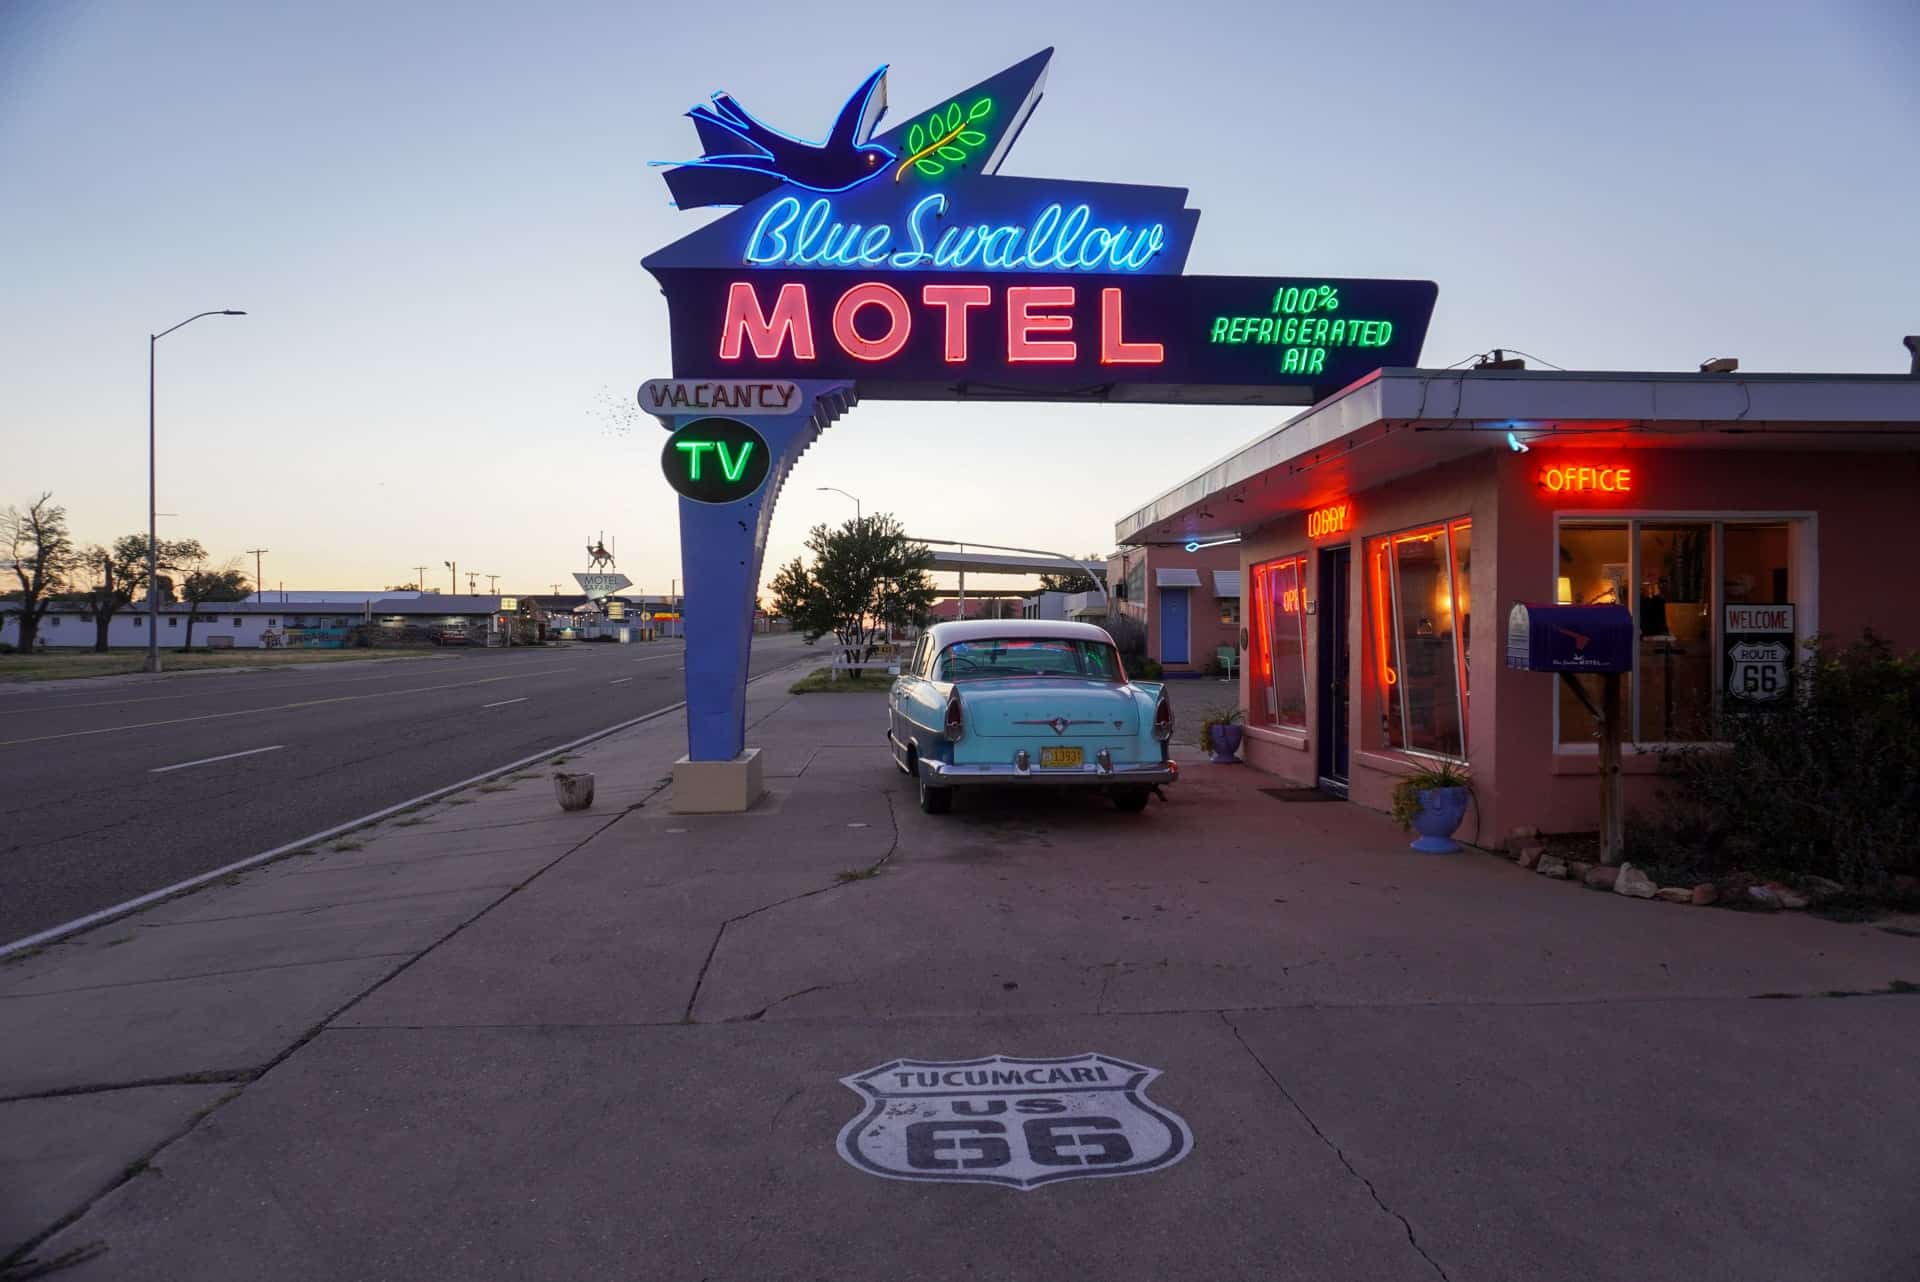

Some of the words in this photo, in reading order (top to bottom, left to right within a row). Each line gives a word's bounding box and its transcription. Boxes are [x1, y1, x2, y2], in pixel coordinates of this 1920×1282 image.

[743, 195, 894, 266] Blue
[893, 193, 1165, 271] Swallow
[1271, 285, 1339, 314] 100%
[719, 281, 1165, 364] MOTEL
[1211, 317, 1393, 347] REFRIGERATED
[1280, 347, 1326, 374] AIR
[650, 383, 795, 408] VACANCY
[675, 441, 755, 481] TV
[1545, 466, 1632, 492] OFFICE
[1307, 504, 1347, 538] LOBBY
[1728, 609, 1789, 630] WELCOME
[1741, 649, 1778, 660] ROUTE
[1743, 664, 1778, 693] 66
[893, 1065, 1109, 1089] TUCUMCARI
[951, 1098, 1068, 1116] US
[905, 1116, 1135, 1169] 66
